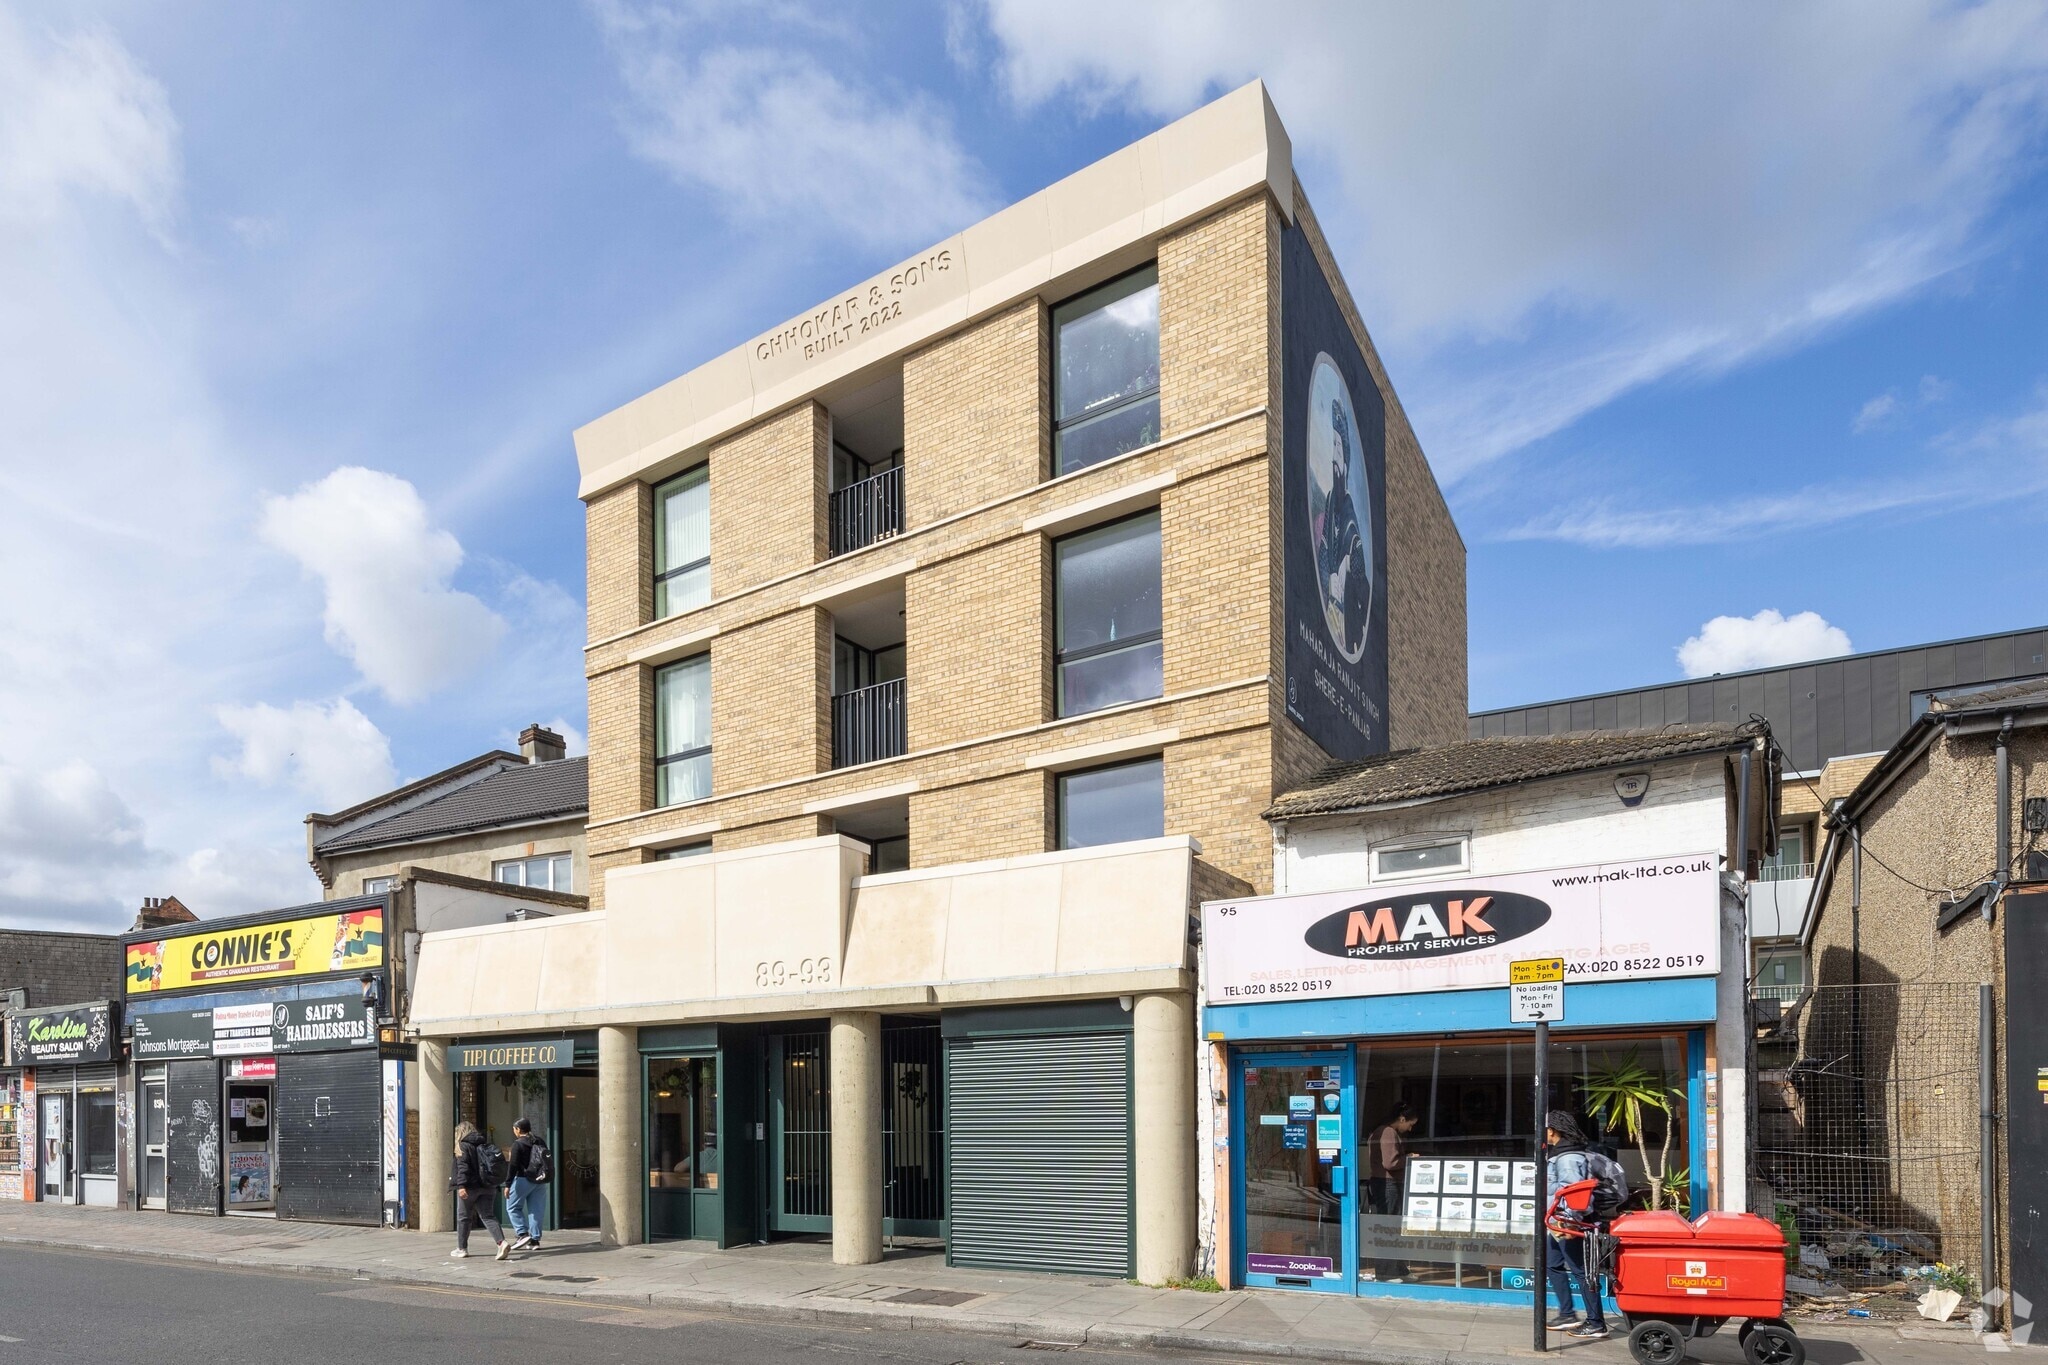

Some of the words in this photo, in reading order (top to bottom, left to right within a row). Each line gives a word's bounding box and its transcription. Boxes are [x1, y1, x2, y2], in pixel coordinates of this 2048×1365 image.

[756, 296, 860, 360] CHHOKAR
[869, 285, 884, 306] &
[890, 250, 952, 294] SONS
[804, 324, 853, 360] BUILT
[860, 301, 902, 334] 2022
[1300, 618, 1336, 675] MAHARAJA
[1337, 662, 1360, 701] RANJIT
[1361, 691, 1380, 723] SINGH
[1552, 860, 1712, 887] www.mak-ltd.co.uk
[1220, 907, 1237, 917] 95
[1345, 896, 1498, 948] MAK
[192, 929, 292, 969] CONNIE'S
[1348, 941, 1420, 956] PROPERTY
[1424, 935, 1496, 950] SERVICES
[205, 970, 228, 978] AUTHENTIC
[251, 963, 280, 973] RESTAURANT
[756, 957, 831, 988] 89-93
[1373, 953, 1497, 973] MANAGEMENT
[1502, 952, 1516, 963] &
[1624, 957, 1661, 971] 8522
[1666, 954, 1705, 968] 0519
[1269, 982, 1298, 993] 8522
[1302, 980, 1332, 991] 0519
[305, 1003, 345, 1021] SAIF'S
[28, 1016, 88, 1042] Karolina
[286, 1020, 365, 1042] HAIRDRESSERS
[31, 1043, 58, 1054] BEAUTY
[59, 1041, 84, 1052] SALON
[139, 1040, 166, 1053] Johnsons
[463, 1049, 487, 1067] TIPI
[489, 1047, 536, 1065] COFFEE
[539, 1046, 556, 1063] CO.
[1374, 1237, 1414, 1249] Vendors
[1416, 1239, 1425, 1249] &
[1427, 1240, 1479, 1252] Landlords
[1482, 1243, 1530, 1256] Required
[1671, 1277, 1699, 1287] Royal
[1700, 1278, 1722, 1287] Mail
